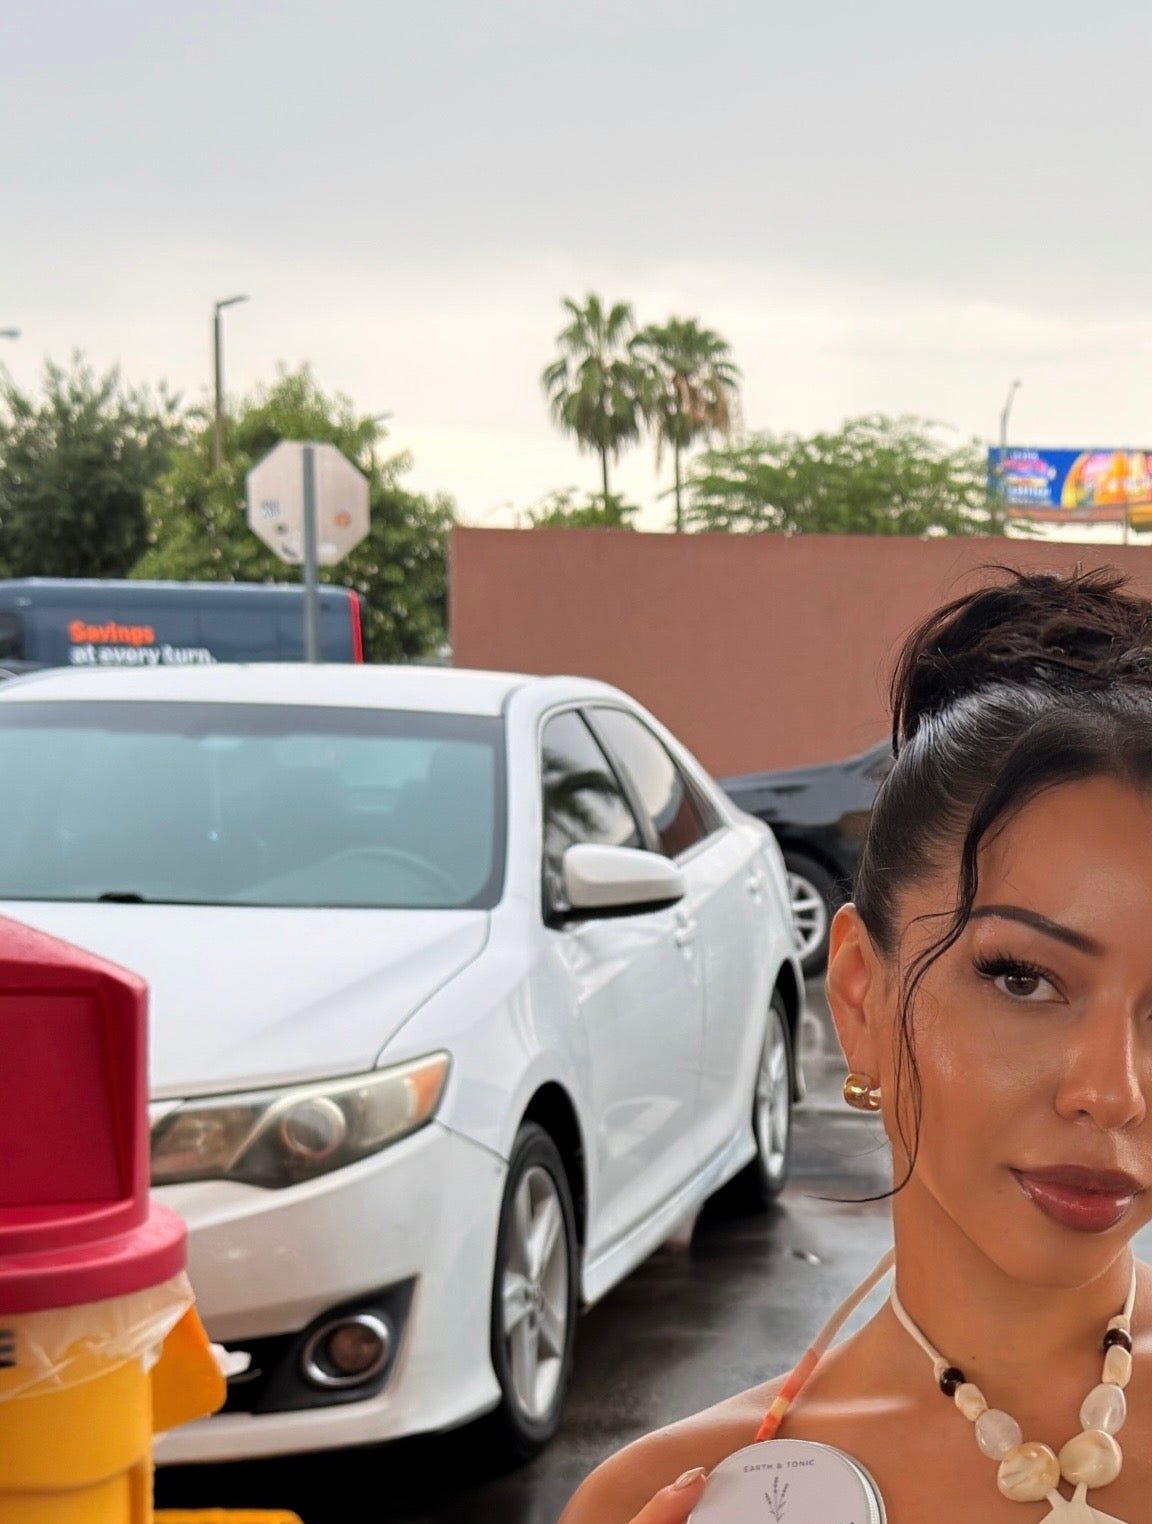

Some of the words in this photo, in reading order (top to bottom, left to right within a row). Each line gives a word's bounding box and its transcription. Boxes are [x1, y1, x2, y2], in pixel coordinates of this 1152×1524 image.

[70, 619, 154, 646] Savings
[70, 643, 95, 665] at
[98, 646, 160, 666] every
[743, 1464, 773, 1473] EARTH
[786, 1459, 815, 1468] TONIC
